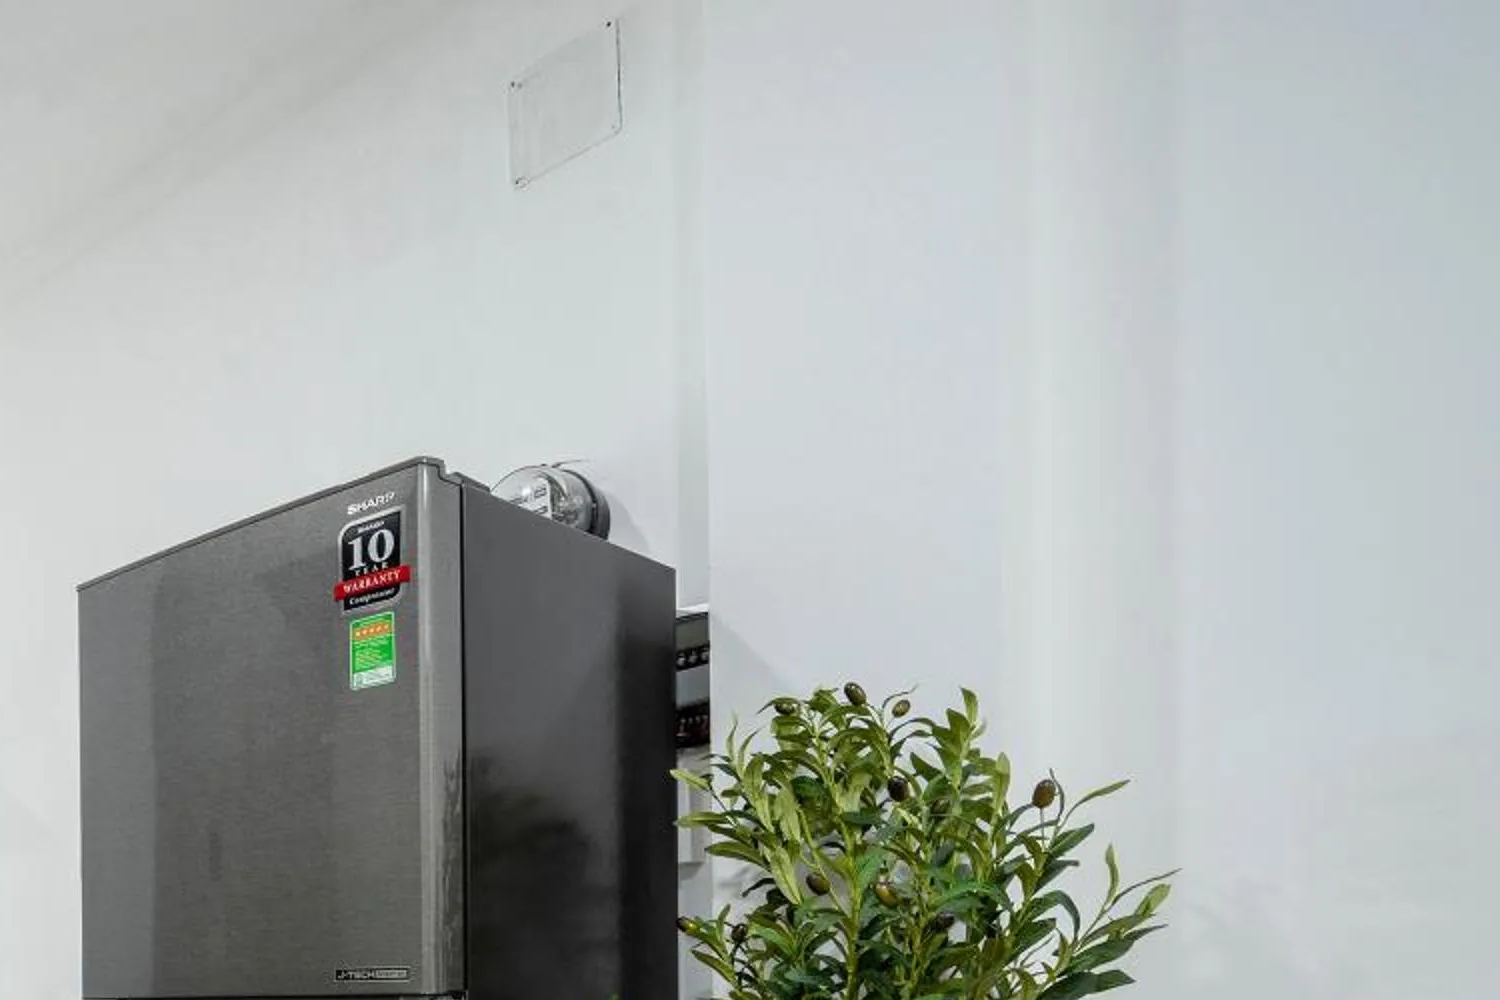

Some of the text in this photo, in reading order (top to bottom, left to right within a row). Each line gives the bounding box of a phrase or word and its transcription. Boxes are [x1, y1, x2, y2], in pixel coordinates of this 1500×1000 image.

[347, 491, 395, 515] SHARP
[348, 528, 395, 571] 10
[343, 569, 401, 593] WARRANTY
